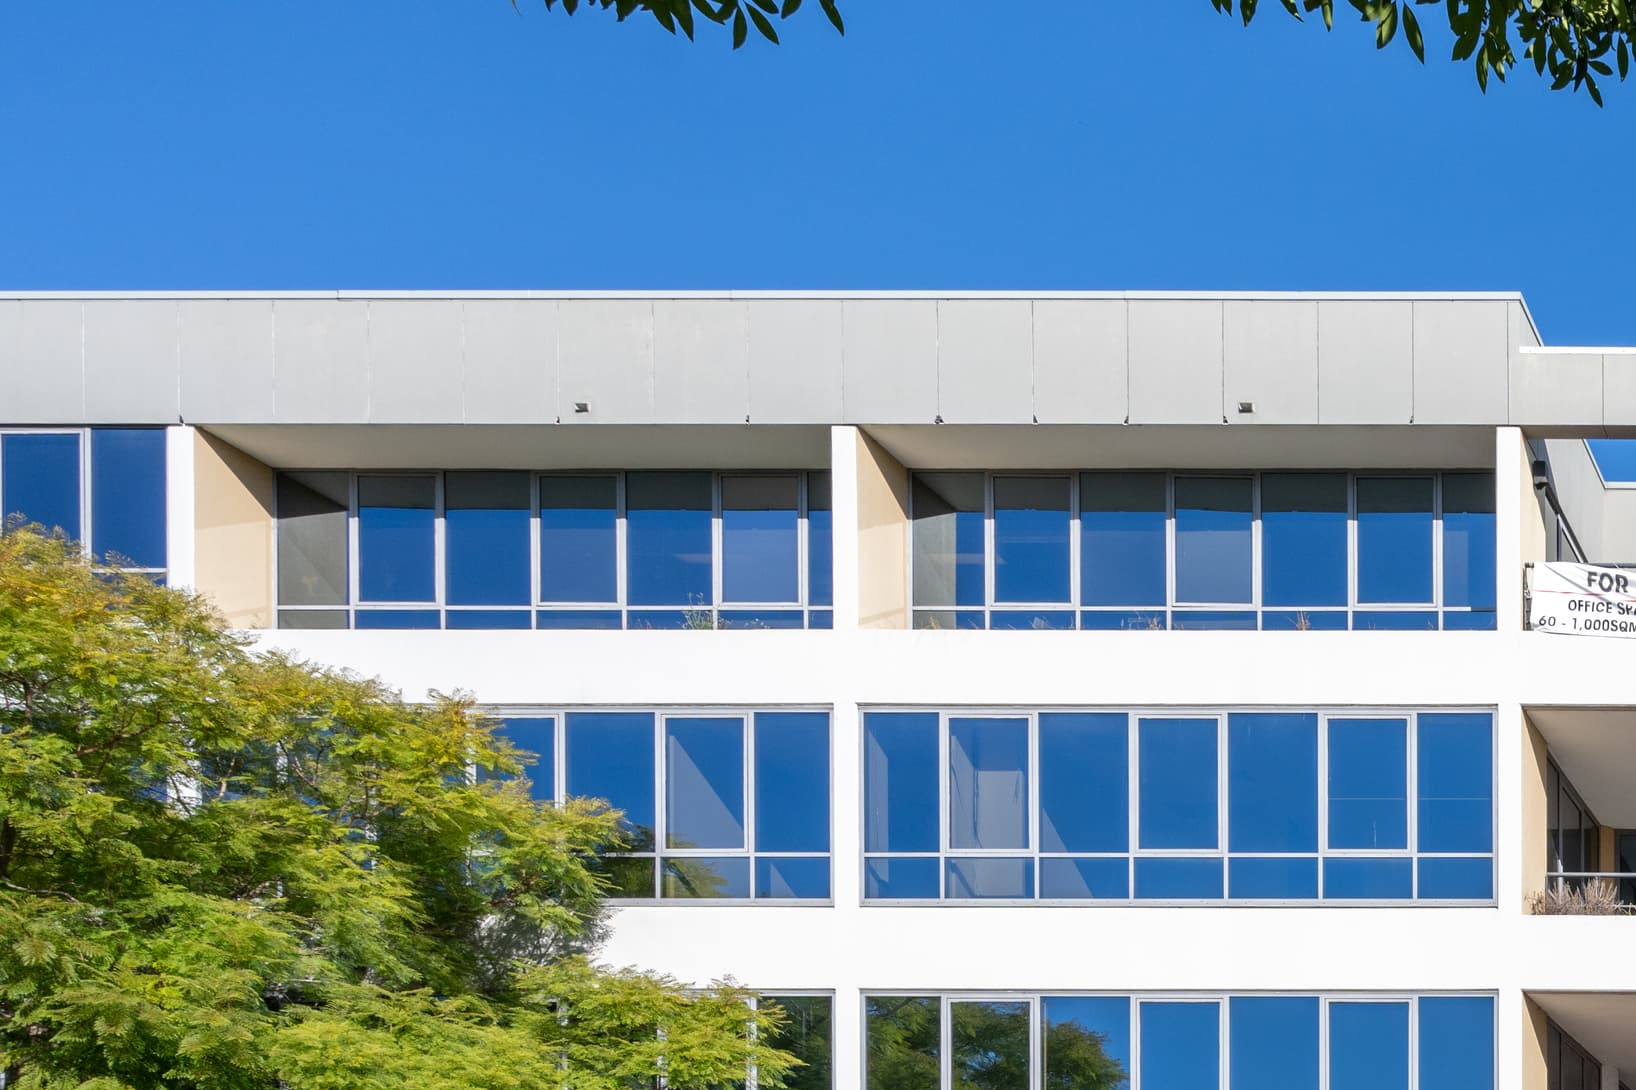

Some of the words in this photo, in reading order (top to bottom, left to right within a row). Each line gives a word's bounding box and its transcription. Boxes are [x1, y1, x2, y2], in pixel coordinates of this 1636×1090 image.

[1586, 571, 1629, 594] FOR
[1567, 599, 1613, 614] OFFICE
[1538, 615, 1557, 628] 60
